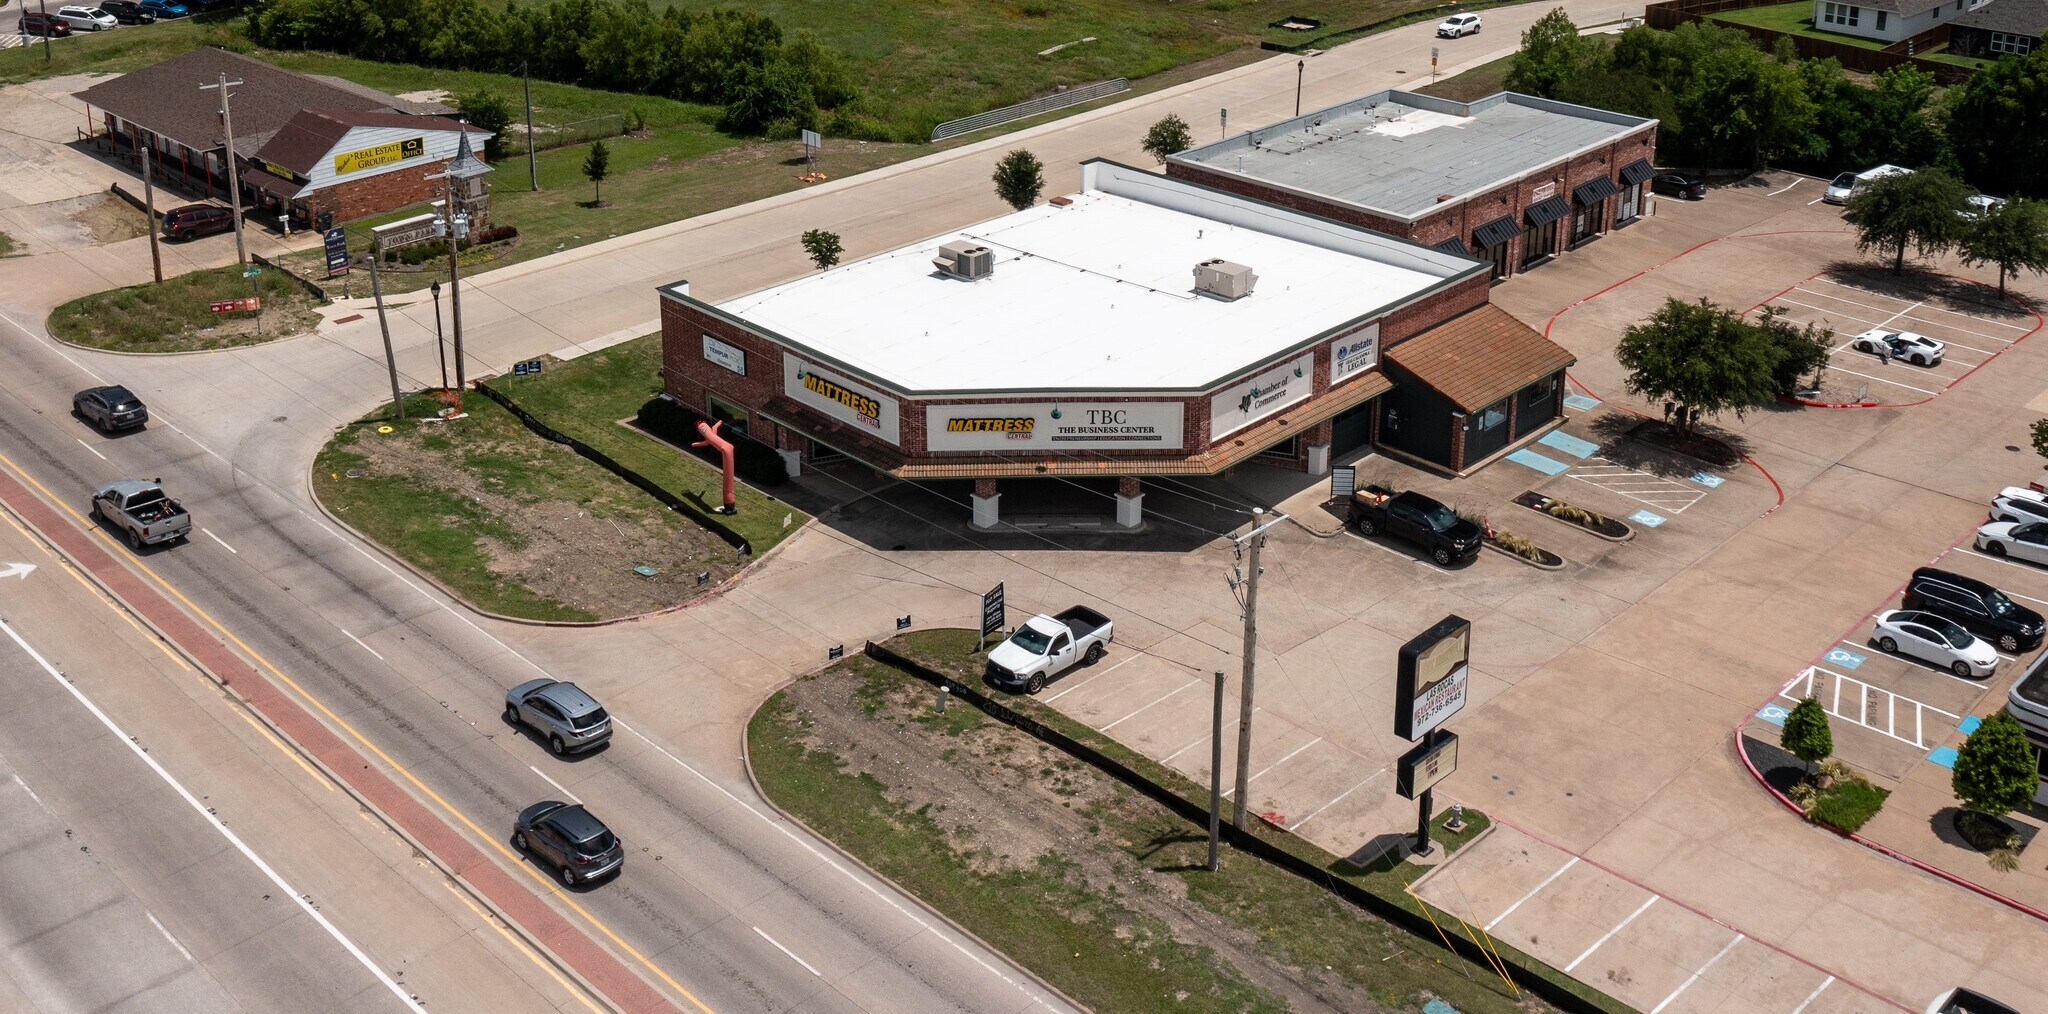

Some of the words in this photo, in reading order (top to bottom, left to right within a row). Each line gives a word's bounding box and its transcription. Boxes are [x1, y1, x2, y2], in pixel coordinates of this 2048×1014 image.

[354, 150, 374, 160] REAL
[375, 143, 401, 156] ESTATE
[402, 148, 422, 158] OFFICE
[388, 232, 411, 245] TOWN
[1349, 338, 1372, 354] Allstate
[1347, 357, 1367, 371] LEGAL
[1257, 382, 1281, 397] hamber
[1281, 376, 1288, 385] of
[804, 372, 880, 418] MATTRESS
[1254, 389, 1287, 409] Commerce
[857, 413, 880, 429] CENTRAL
[1086, 409, 1127, 424] TBC
[947, 418, 1035, 432] MATTRESS
[1058, 426, 1076, 434] THE
[1078, 426, 1118, 434] BUSINESS
[1120, 426, 1155, 434] CENTER
[1007, 432, 1032, 440] CENTRAL
[1426, 686, 1437, 701] LAS
[1436, 675, 1454, 696] ROCAS
[1414, 696, 1435, 719] MEXICAN
[1434, 677, 1466, 704] RESTAURANT
[1417, 690, 1462, 727] 972-736-6545
